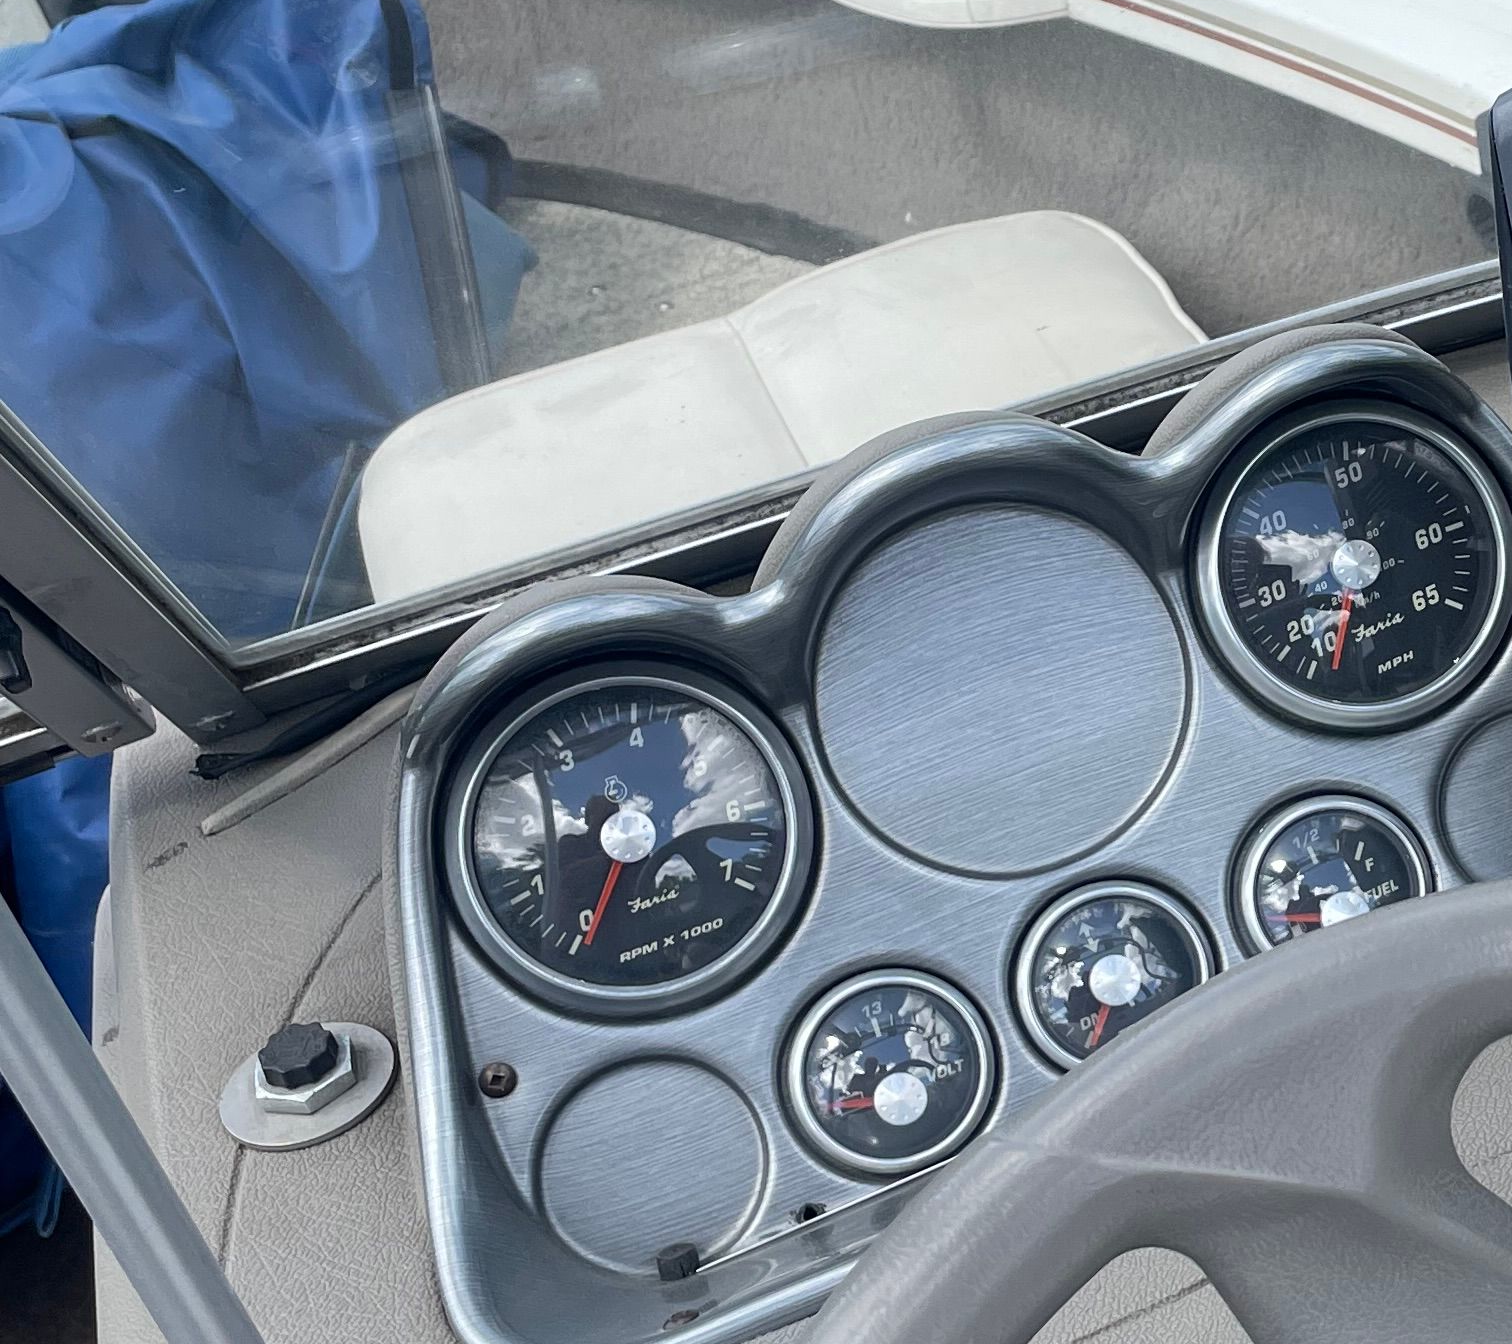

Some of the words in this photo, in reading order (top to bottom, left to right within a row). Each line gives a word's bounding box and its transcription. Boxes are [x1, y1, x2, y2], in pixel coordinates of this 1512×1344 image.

[1335, 461, 1363, 489] 50
[1259, 509, 1287, 535] 40
[1414, 522, 1443, 550] 60
[1379, 557, 1396, 572] 00
[1257, 579, 1287, 608] 30
[1314, 580, 1328, 593] 40
[1411, 583, 1440, 612] 65
[1286, 613, 1315, 643] 20
[1310, 630, 1337, 657] 10
[1377, 649, 1414, 675] MPH
[629, 726, 644, 748] 4
[559, 749, 575, 772] 3
[693, 754, 708, 777] 5
[725, 799, 741, 823] 6
[520, 814, 537, 837] 2
[1292, 828, 1320, 849] 1/2
[719, 858, 733, 882] 7
[1364, 857, 1375, 873] F
[530, 873, 544, 895] 1
[1363, 879, 1400, 903] FUEL
[579, 908, 595, 932] 0
[618, 941, 659, 964] RPM
[662, 934, 676, 948] X
[680, 917, 724, 941] 1000
[861, 1000, 882, 1018] 13
[926, 1058, 964, 1083] VOLT
